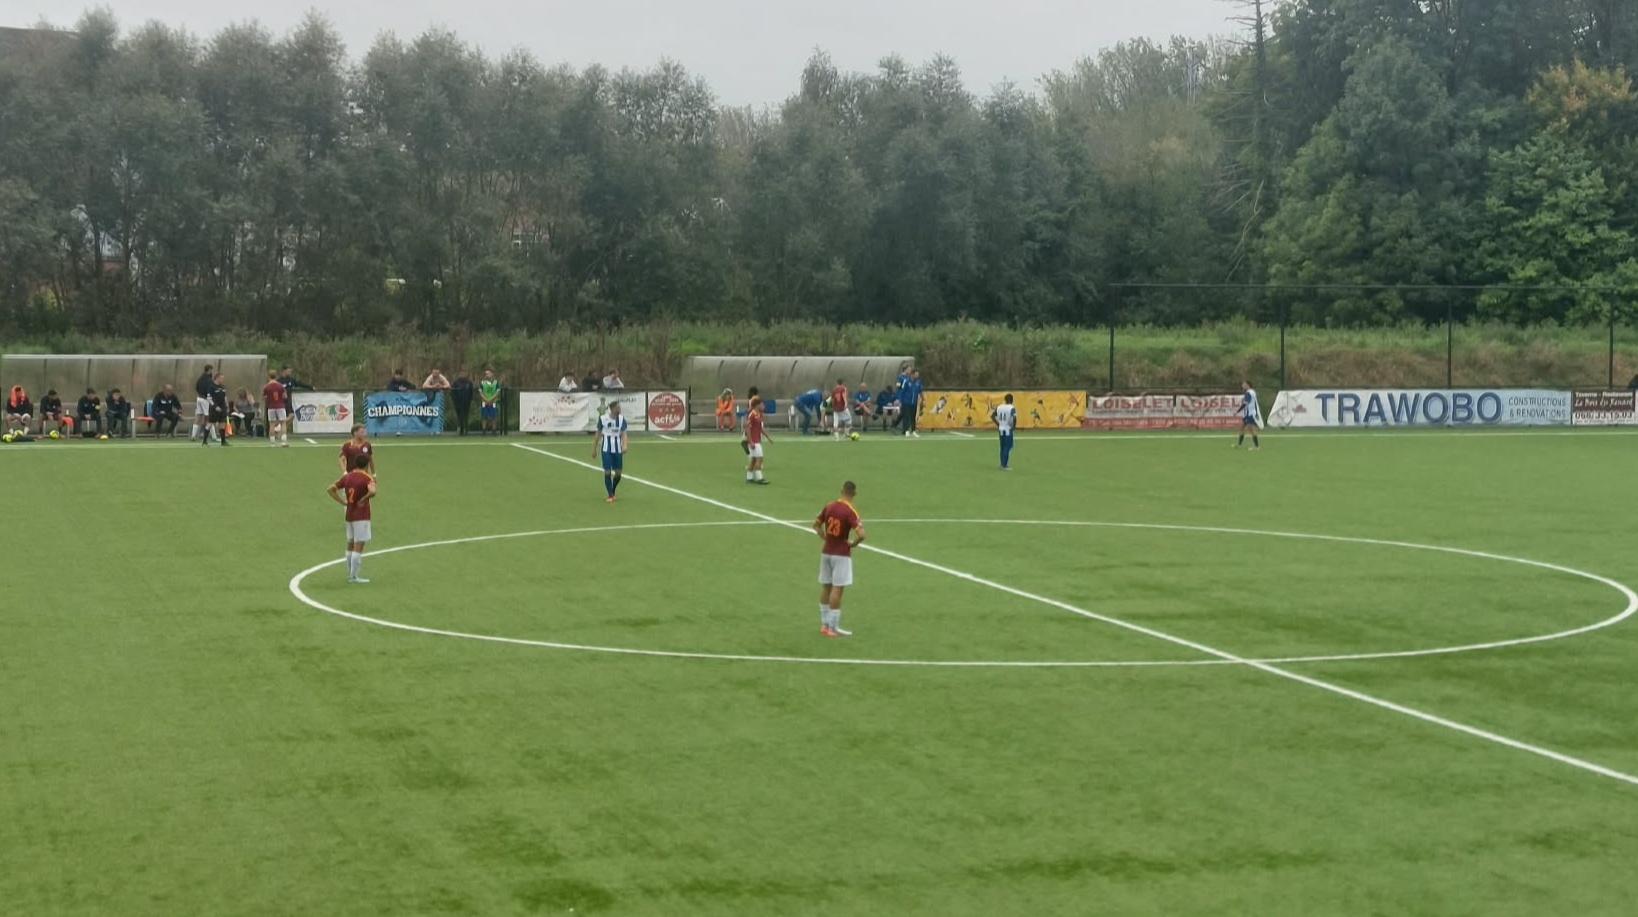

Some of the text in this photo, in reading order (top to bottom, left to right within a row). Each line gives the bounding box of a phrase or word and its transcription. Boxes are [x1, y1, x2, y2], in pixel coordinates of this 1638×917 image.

[1092, 398, 1173, 409] LOISELET
[1180, 397, 1241, 408] LOISEL
[1314, 392, 1502, 423] TRAWOBO
[1508, 397, 1566, 406] CONSTRUCTIONS
[368, 404, 439, 417] CHAMPIONNES
[349, 487, 355, 503] 2
[827, 516, 841, 536] 23
